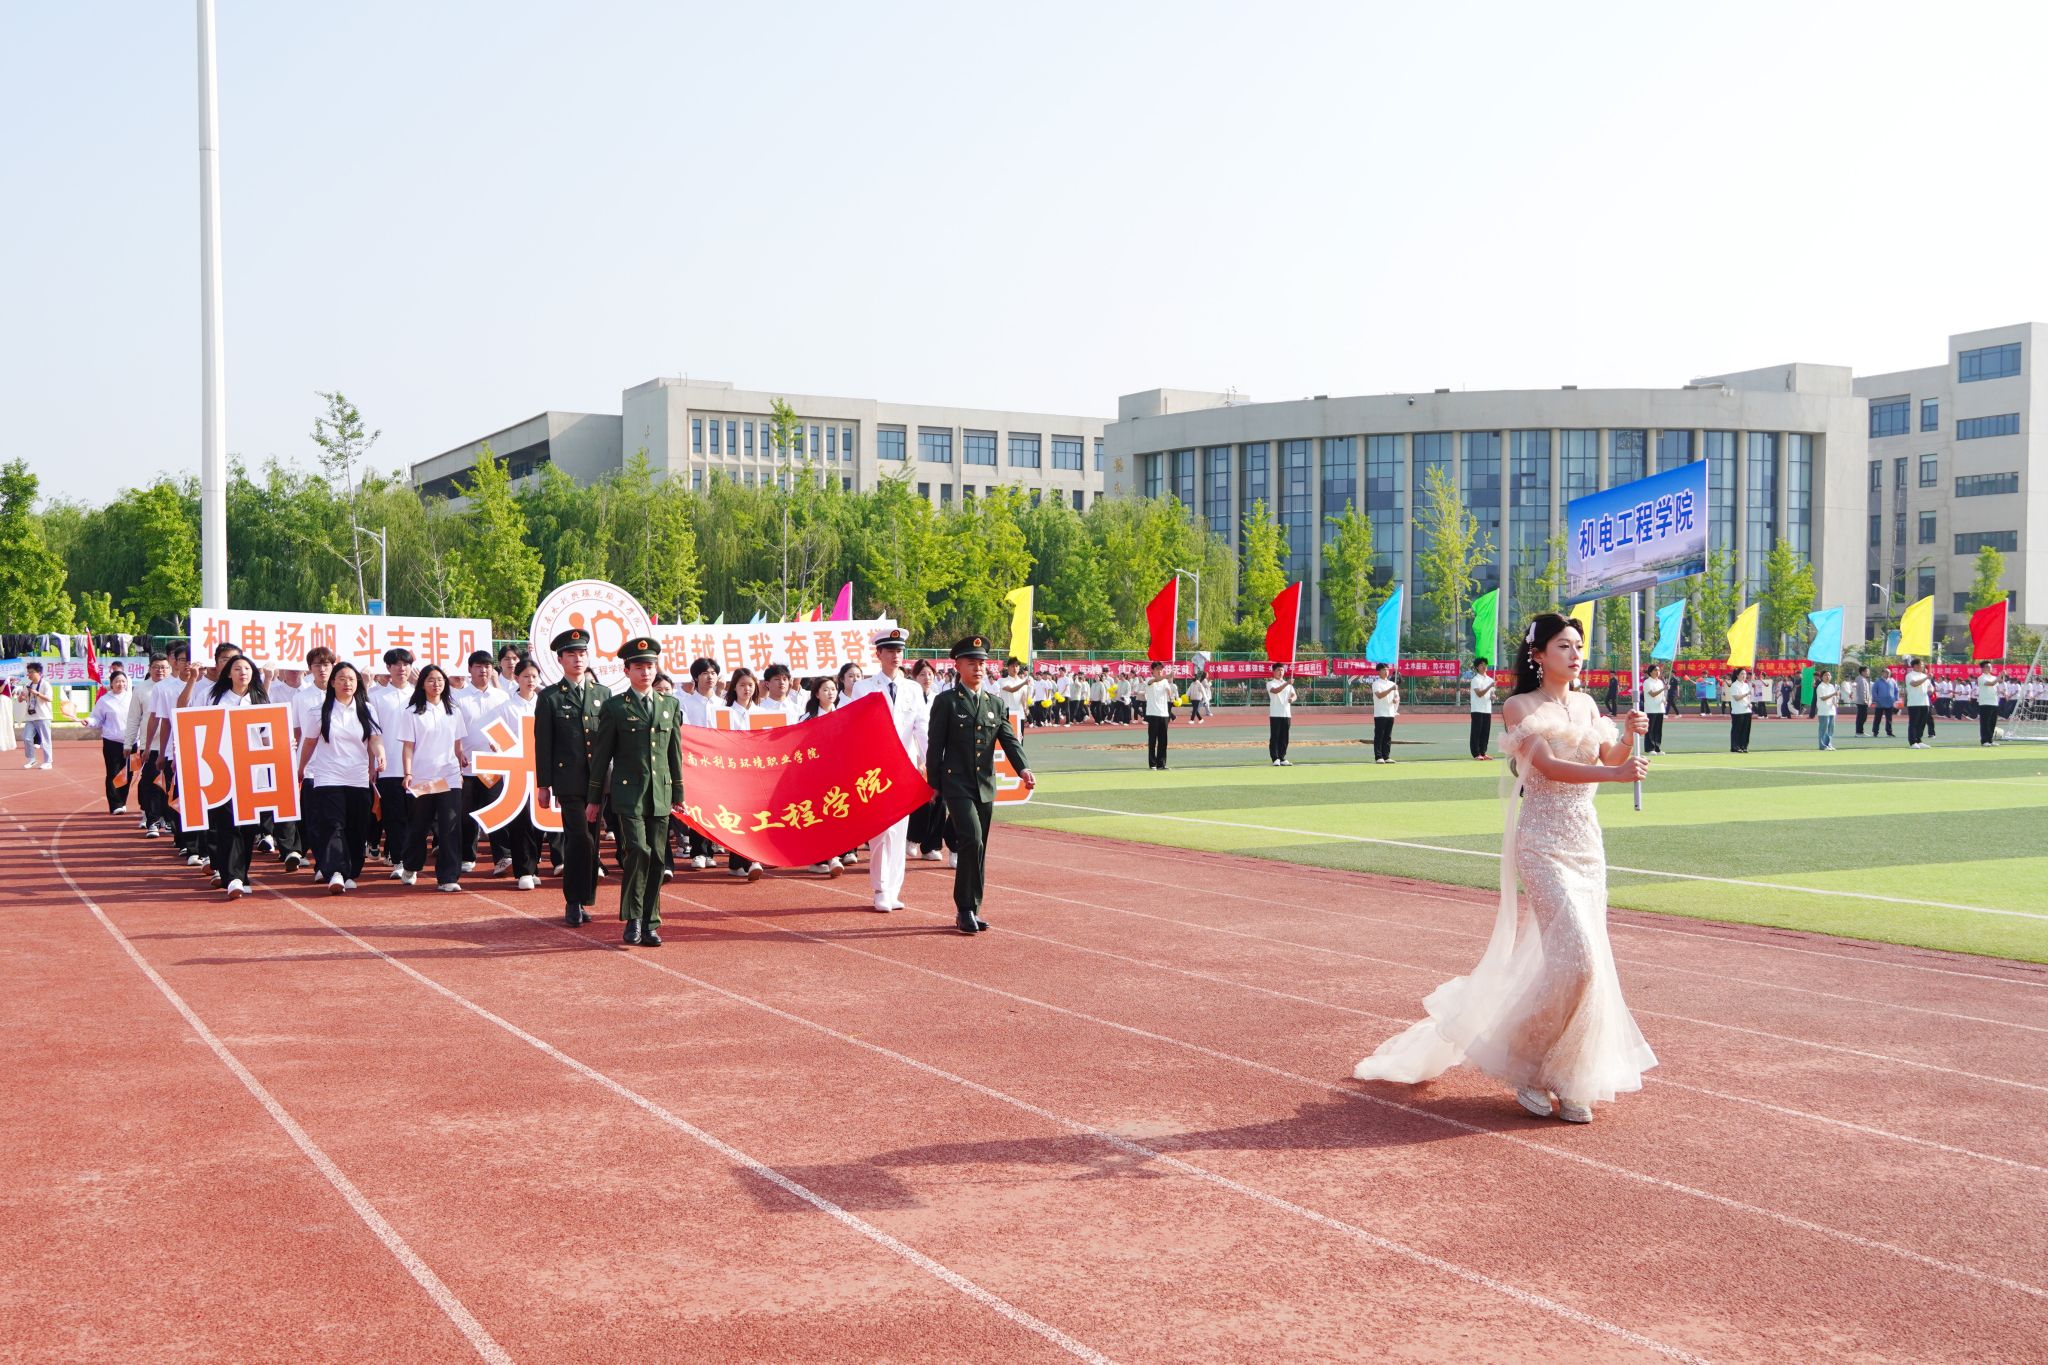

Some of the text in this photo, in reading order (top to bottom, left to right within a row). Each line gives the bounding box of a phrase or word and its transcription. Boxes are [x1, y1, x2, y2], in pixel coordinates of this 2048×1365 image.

[1579, 491, 1694, 560] 机电工程学院
[203, 617, 342, 663] 机电扬帆
[661, 631, 774, 676] 超越自我
[177, 707, 297, 828] 阳
[474, 715, 564, 831] 光
[683, 748, 820, 770] 南水利与环境职业学院
[684, 767, 893, 835] 机电工程学院
